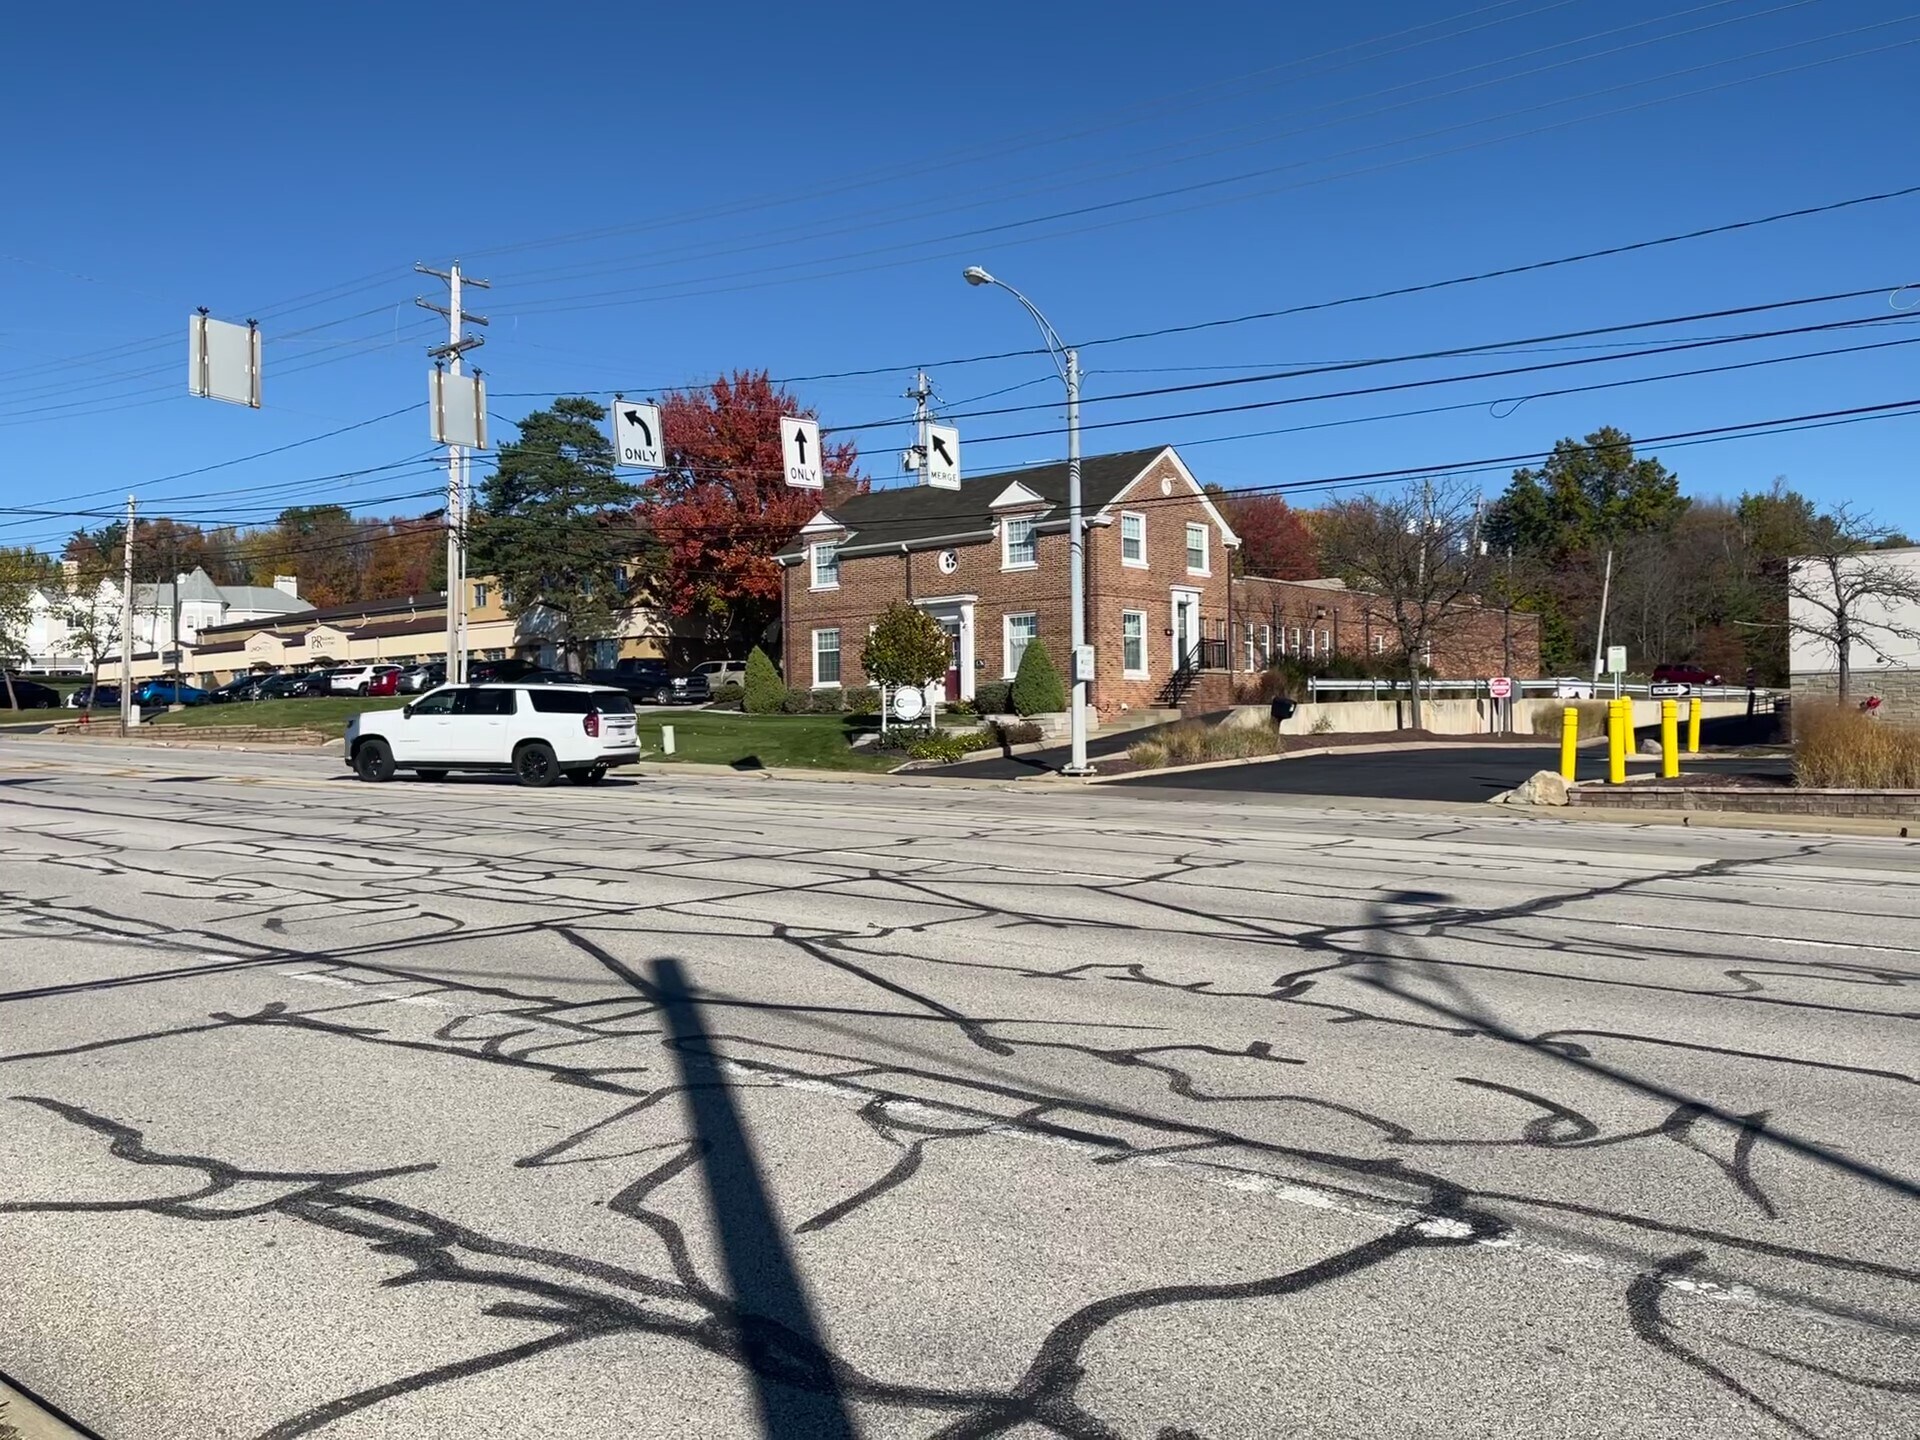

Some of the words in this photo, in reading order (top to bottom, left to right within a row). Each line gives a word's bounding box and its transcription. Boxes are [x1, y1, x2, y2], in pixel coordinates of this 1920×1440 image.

[625, 447, 657, 463] ONLY
[790, 467, 816, 482] ONLY
[930, 471, 958, 482] MERGE
